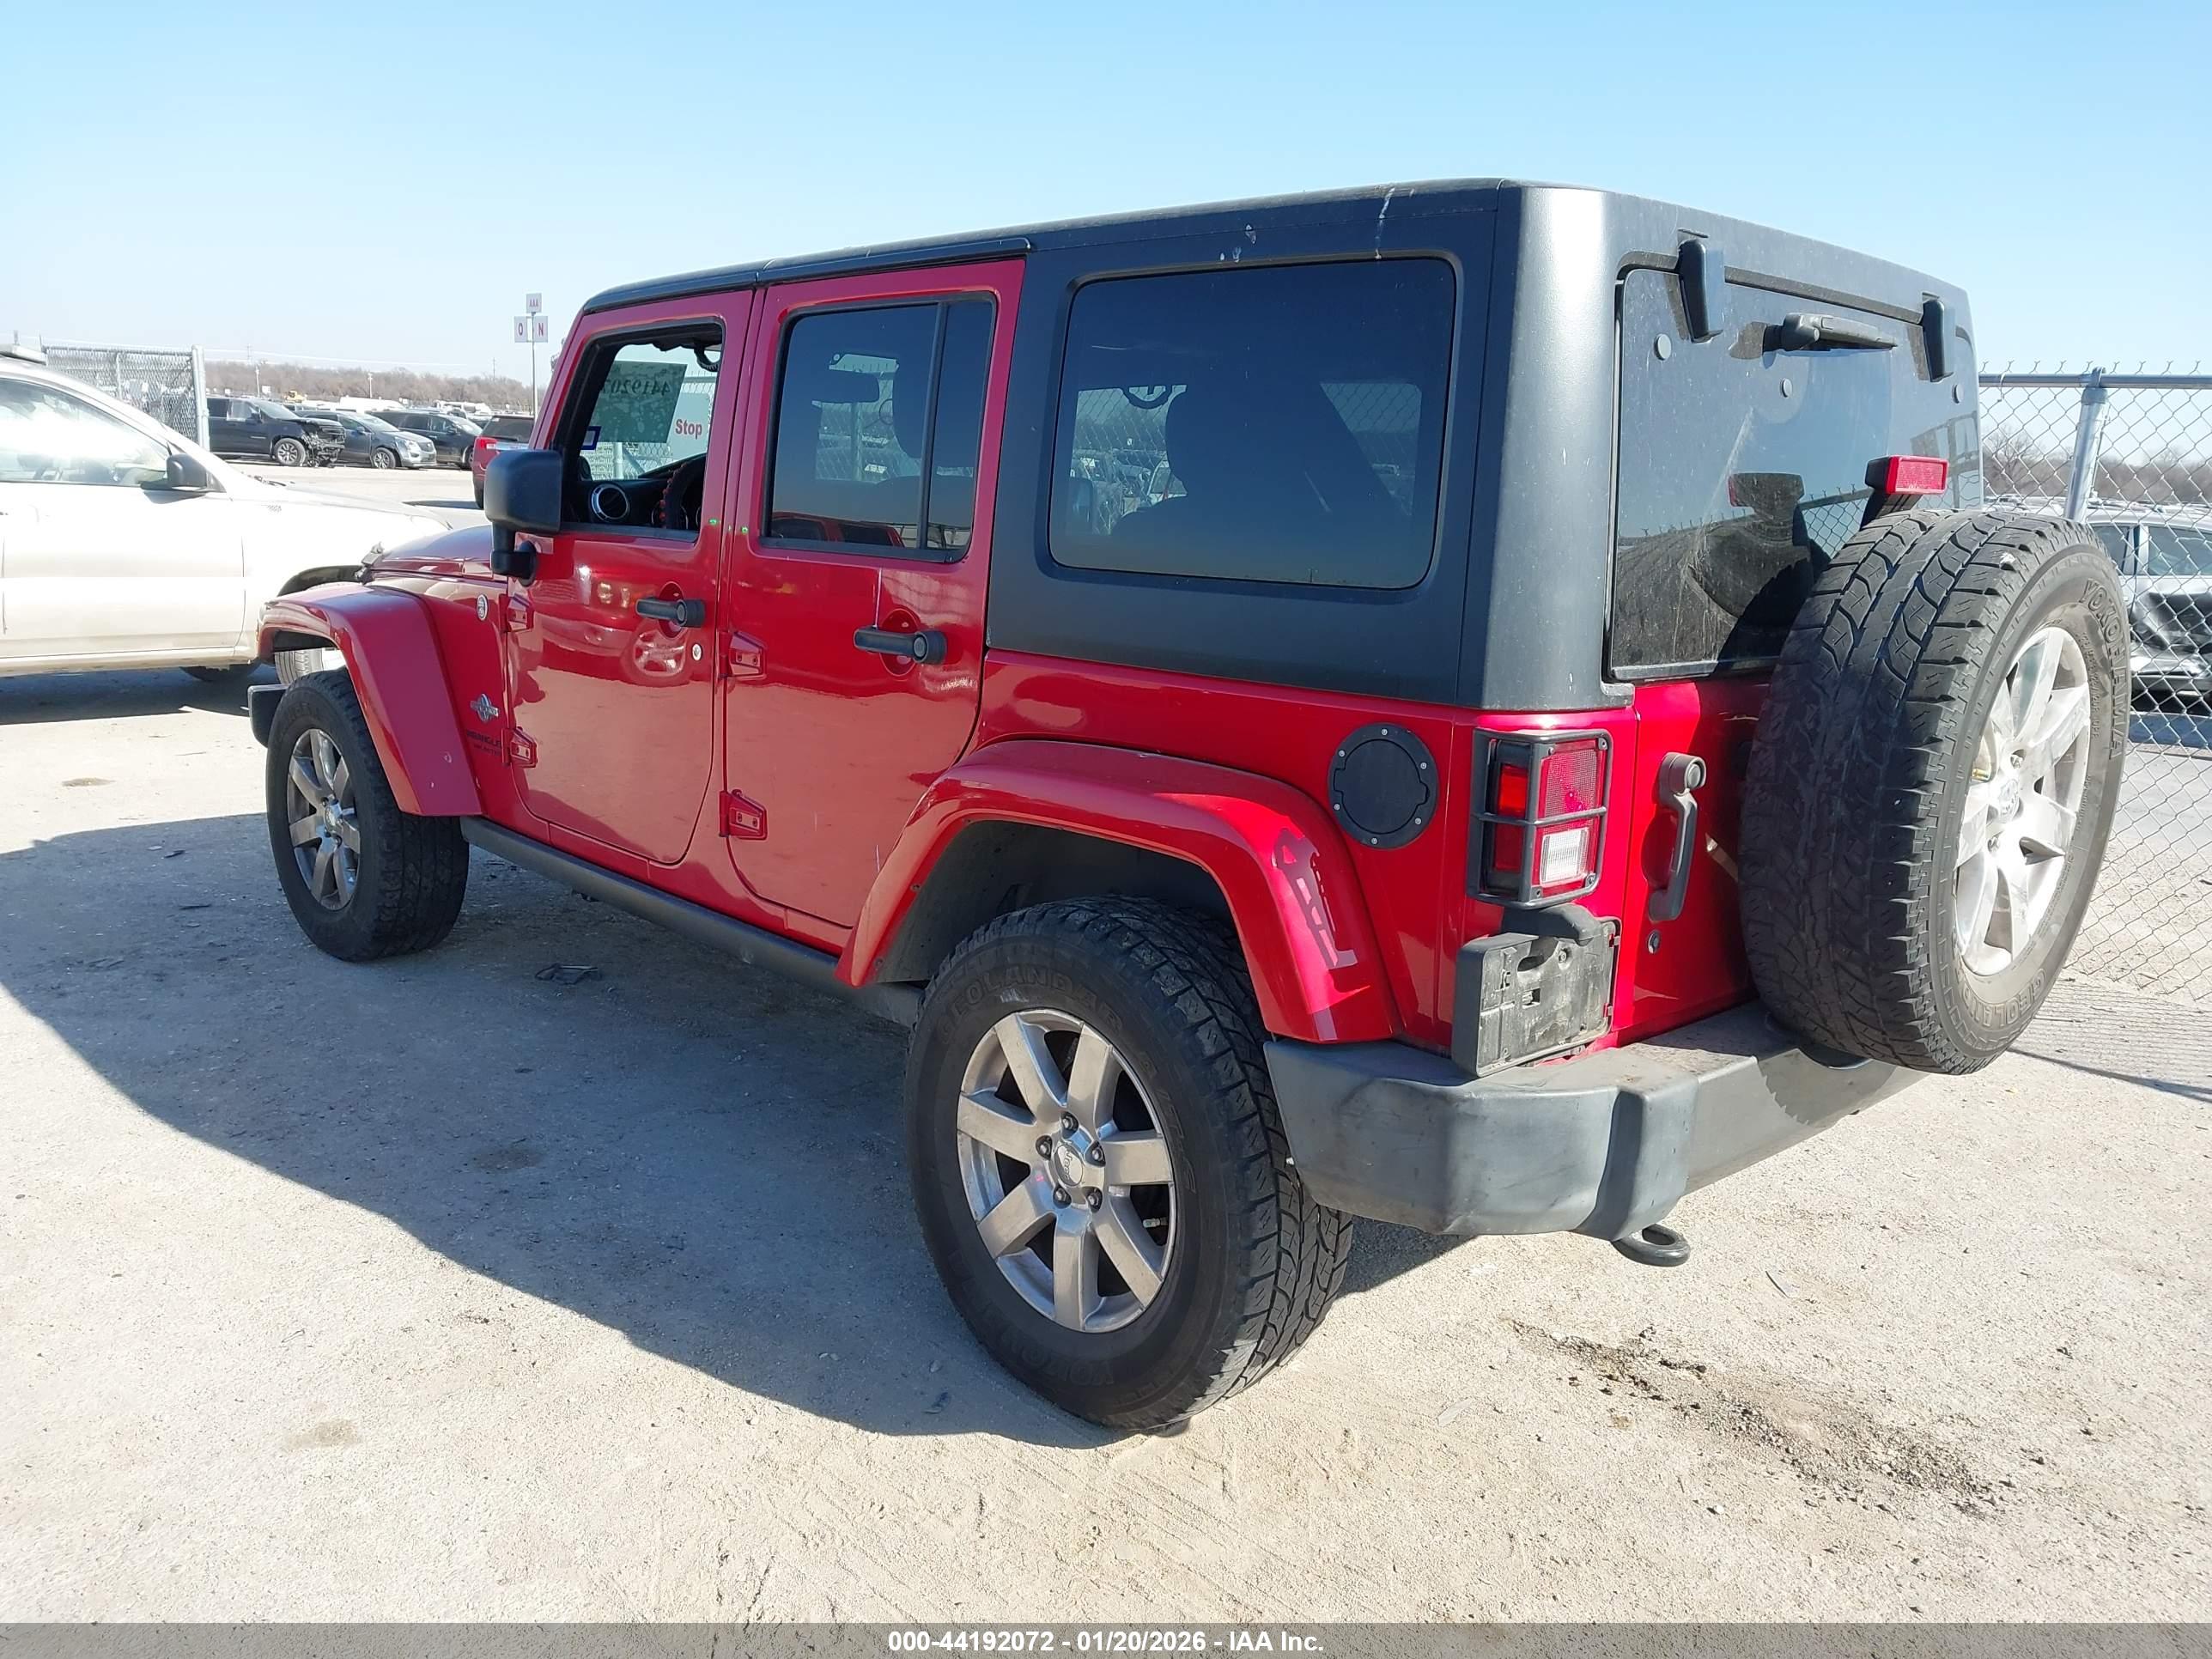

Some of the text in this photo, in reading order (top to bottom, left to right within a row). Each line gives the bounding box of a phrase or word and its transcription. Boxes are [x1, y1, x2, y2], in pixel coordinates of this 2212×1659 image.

[538, 322, 544, 337] N
[675, 418, 702, 439] Stop
[2078, 577, 2128, 760] YOKOHAMA
[935, 964, 1124, 1045] GEOLANDAR
[948, 1251, 1115, 1387] YOKOH
